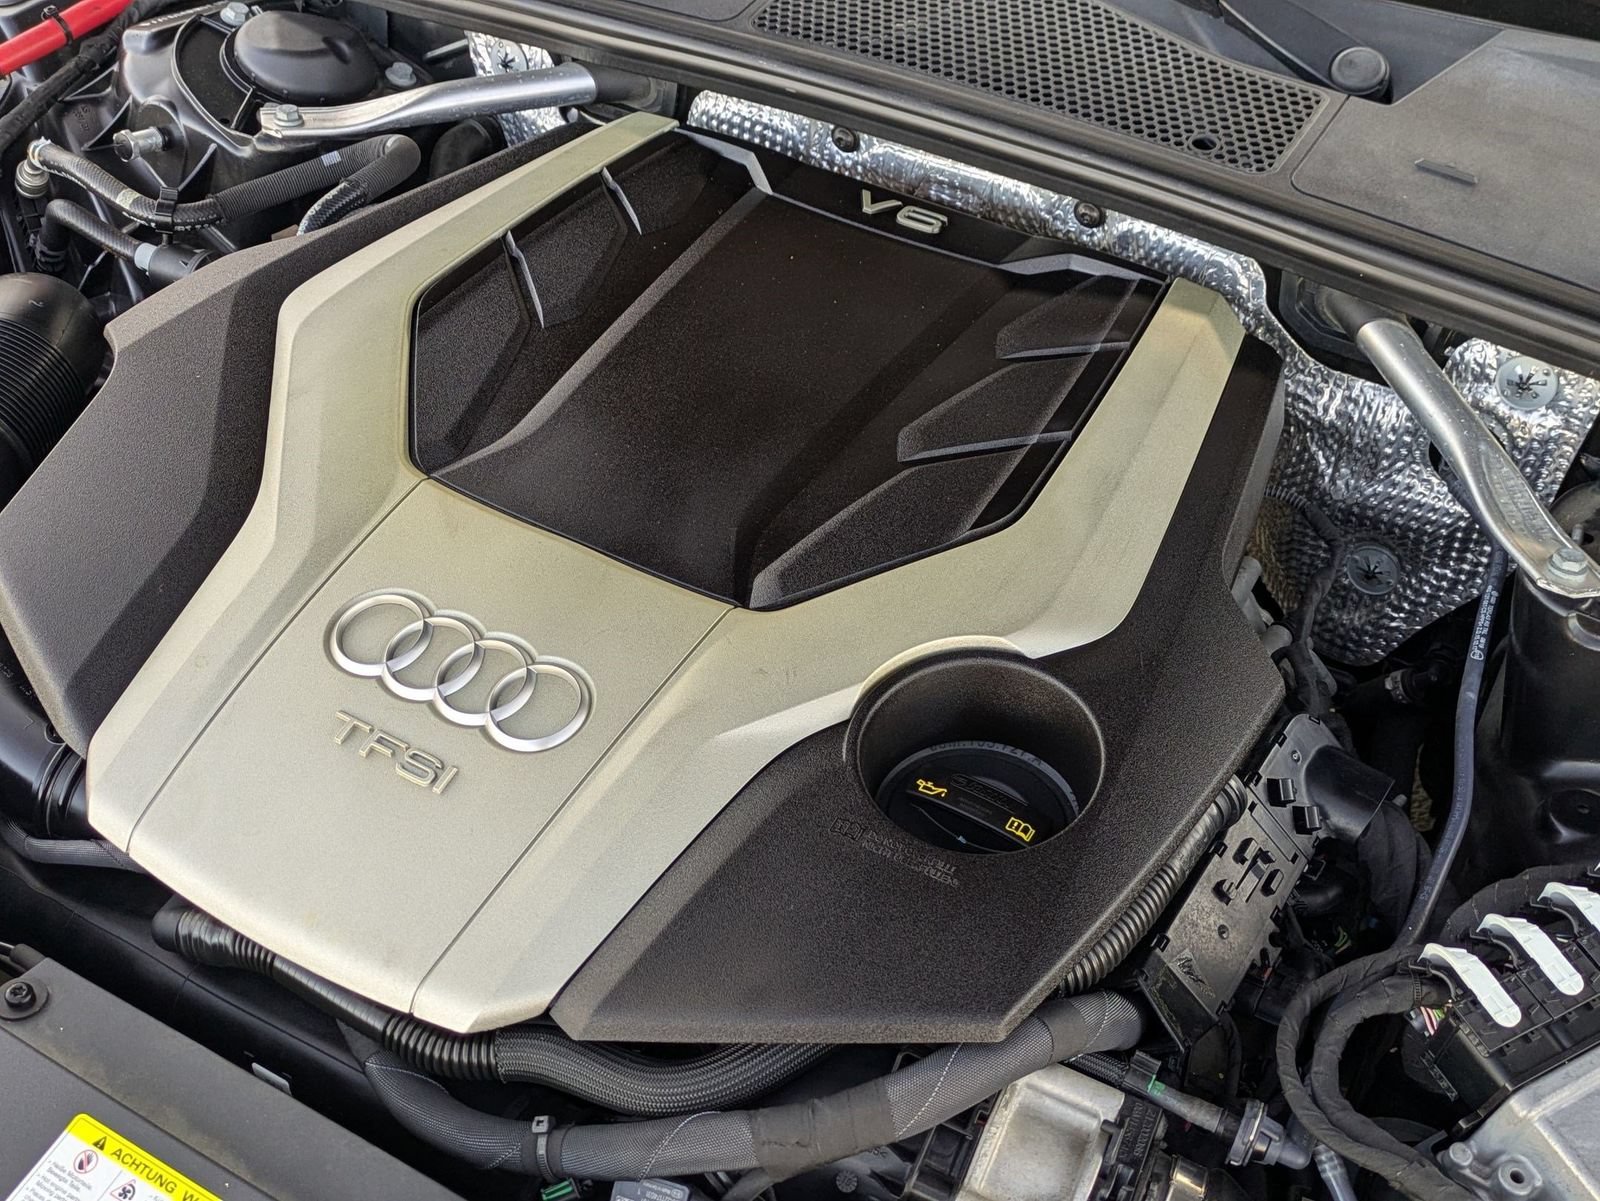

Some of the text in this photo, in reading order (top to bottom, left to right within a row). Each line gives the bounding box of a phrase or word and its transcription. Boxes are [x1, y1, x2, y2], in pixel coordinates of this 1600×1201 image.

[862, 189, 948, 234] V6
[335, 709, 459, 795] TFSI
[110, 1148, 177, 1194] ACHTUNG
